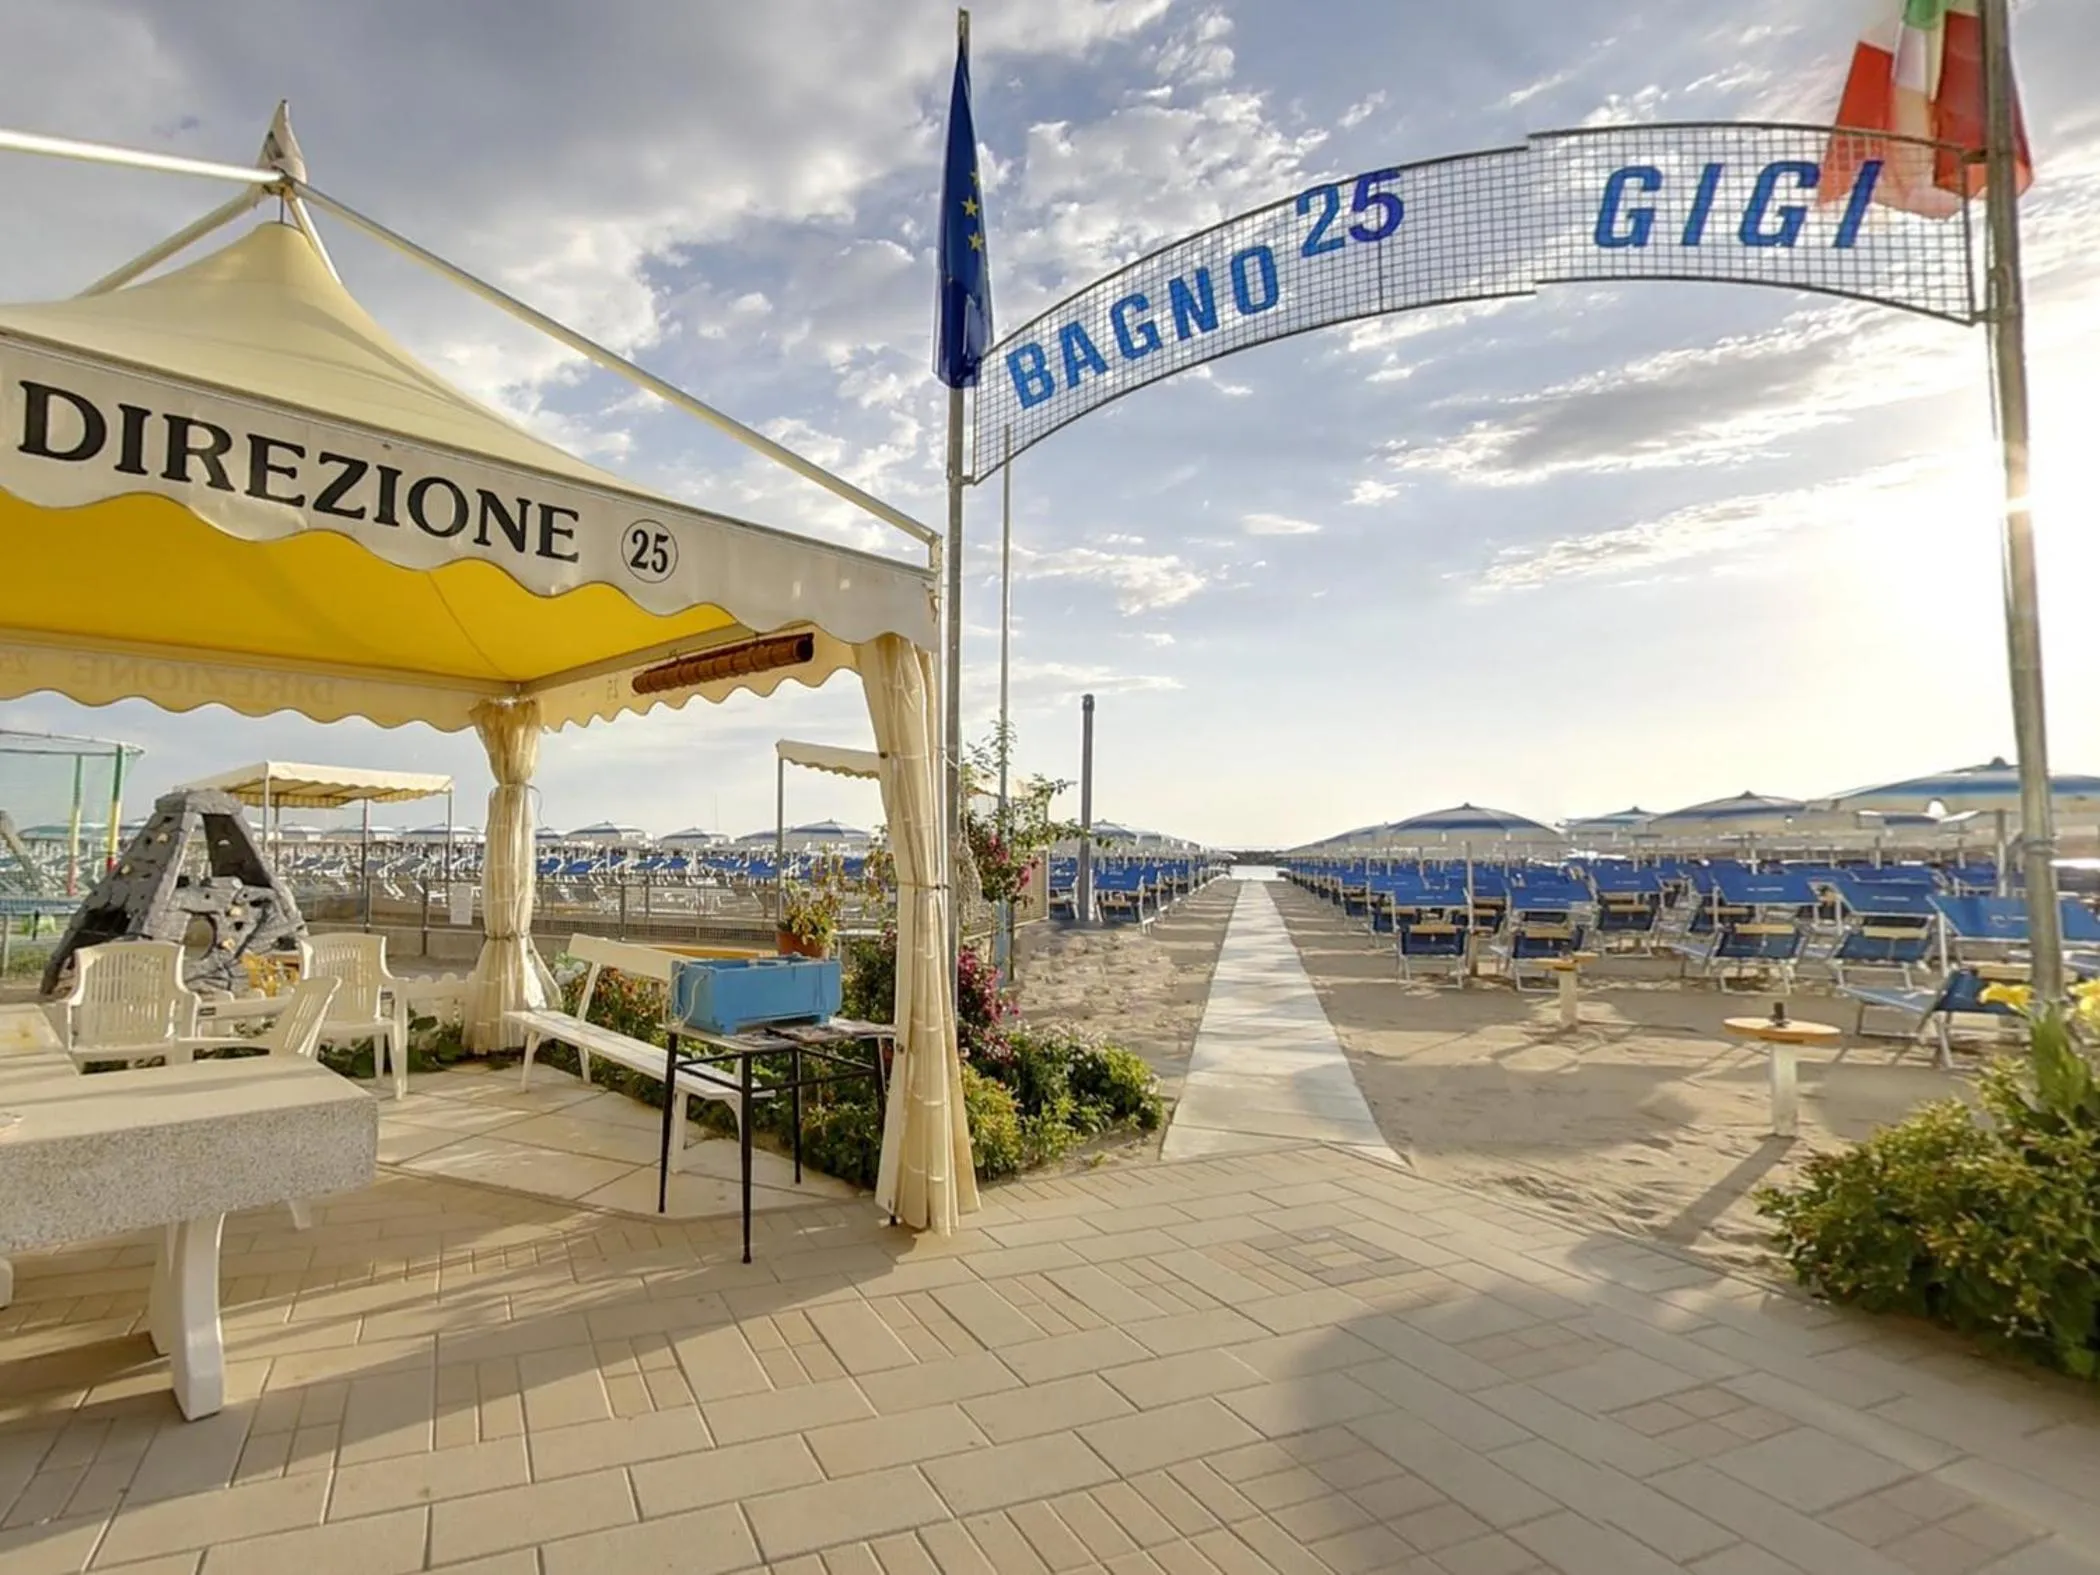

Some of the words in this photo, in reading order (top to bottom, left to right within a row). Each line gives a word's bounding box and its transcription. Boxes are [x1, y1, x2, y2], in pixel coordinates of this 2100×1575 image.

[1005, 245, 1281, 410] BAGNO
[1295, 168, 1405, 259] 25
[1593, 160, 1884, 248] GIGI
[17, 379, 580, 564] DIREZIONE
[629, 526, 670, 575] 25
